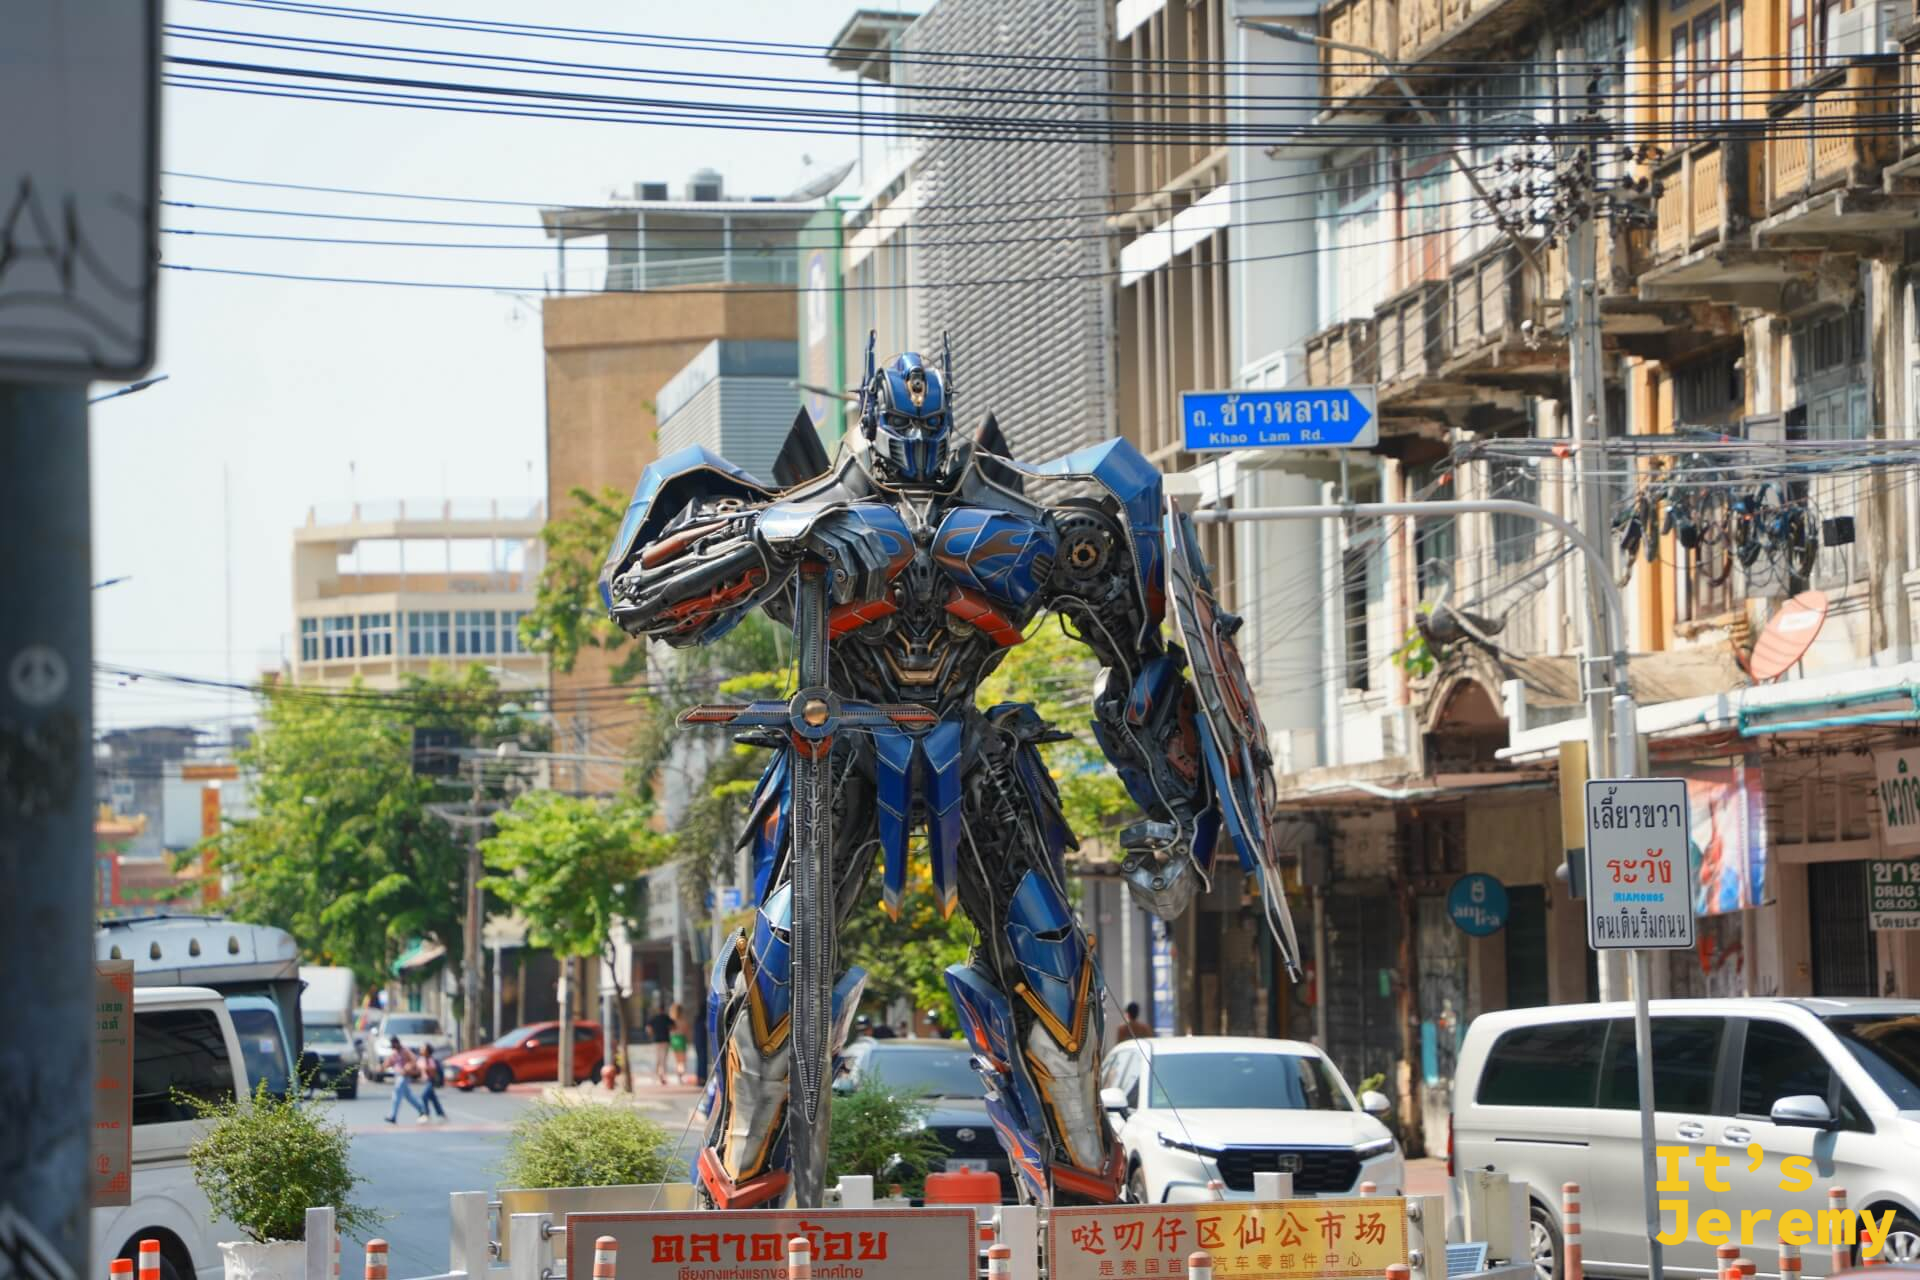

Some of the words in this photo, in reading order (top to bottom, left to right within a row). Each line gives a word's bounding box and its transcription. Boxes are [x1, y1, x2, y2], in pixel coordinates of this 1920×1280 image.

[1220, 394, 1349, 426] ข้าวหลาม
[1209, 432, 1247, 445] Khao
[1259, 430, 1290, 443] Lam
[1301, 429, 1325, 441] Rd.
[1593, 786, 1681, 829] เลี้ยวขวา
[1606, 848, 1672, 884] ระวัง
[1875, 884, 1915, 898] DRUG
[1596, 906, 1686, 939] คนเดินริมถนน
[1071, 1210, 1387, 1255] 哒叻仔区仙公市场
[1098, 1250, 1363, 1277] 是泰国首汽车零部件中心
